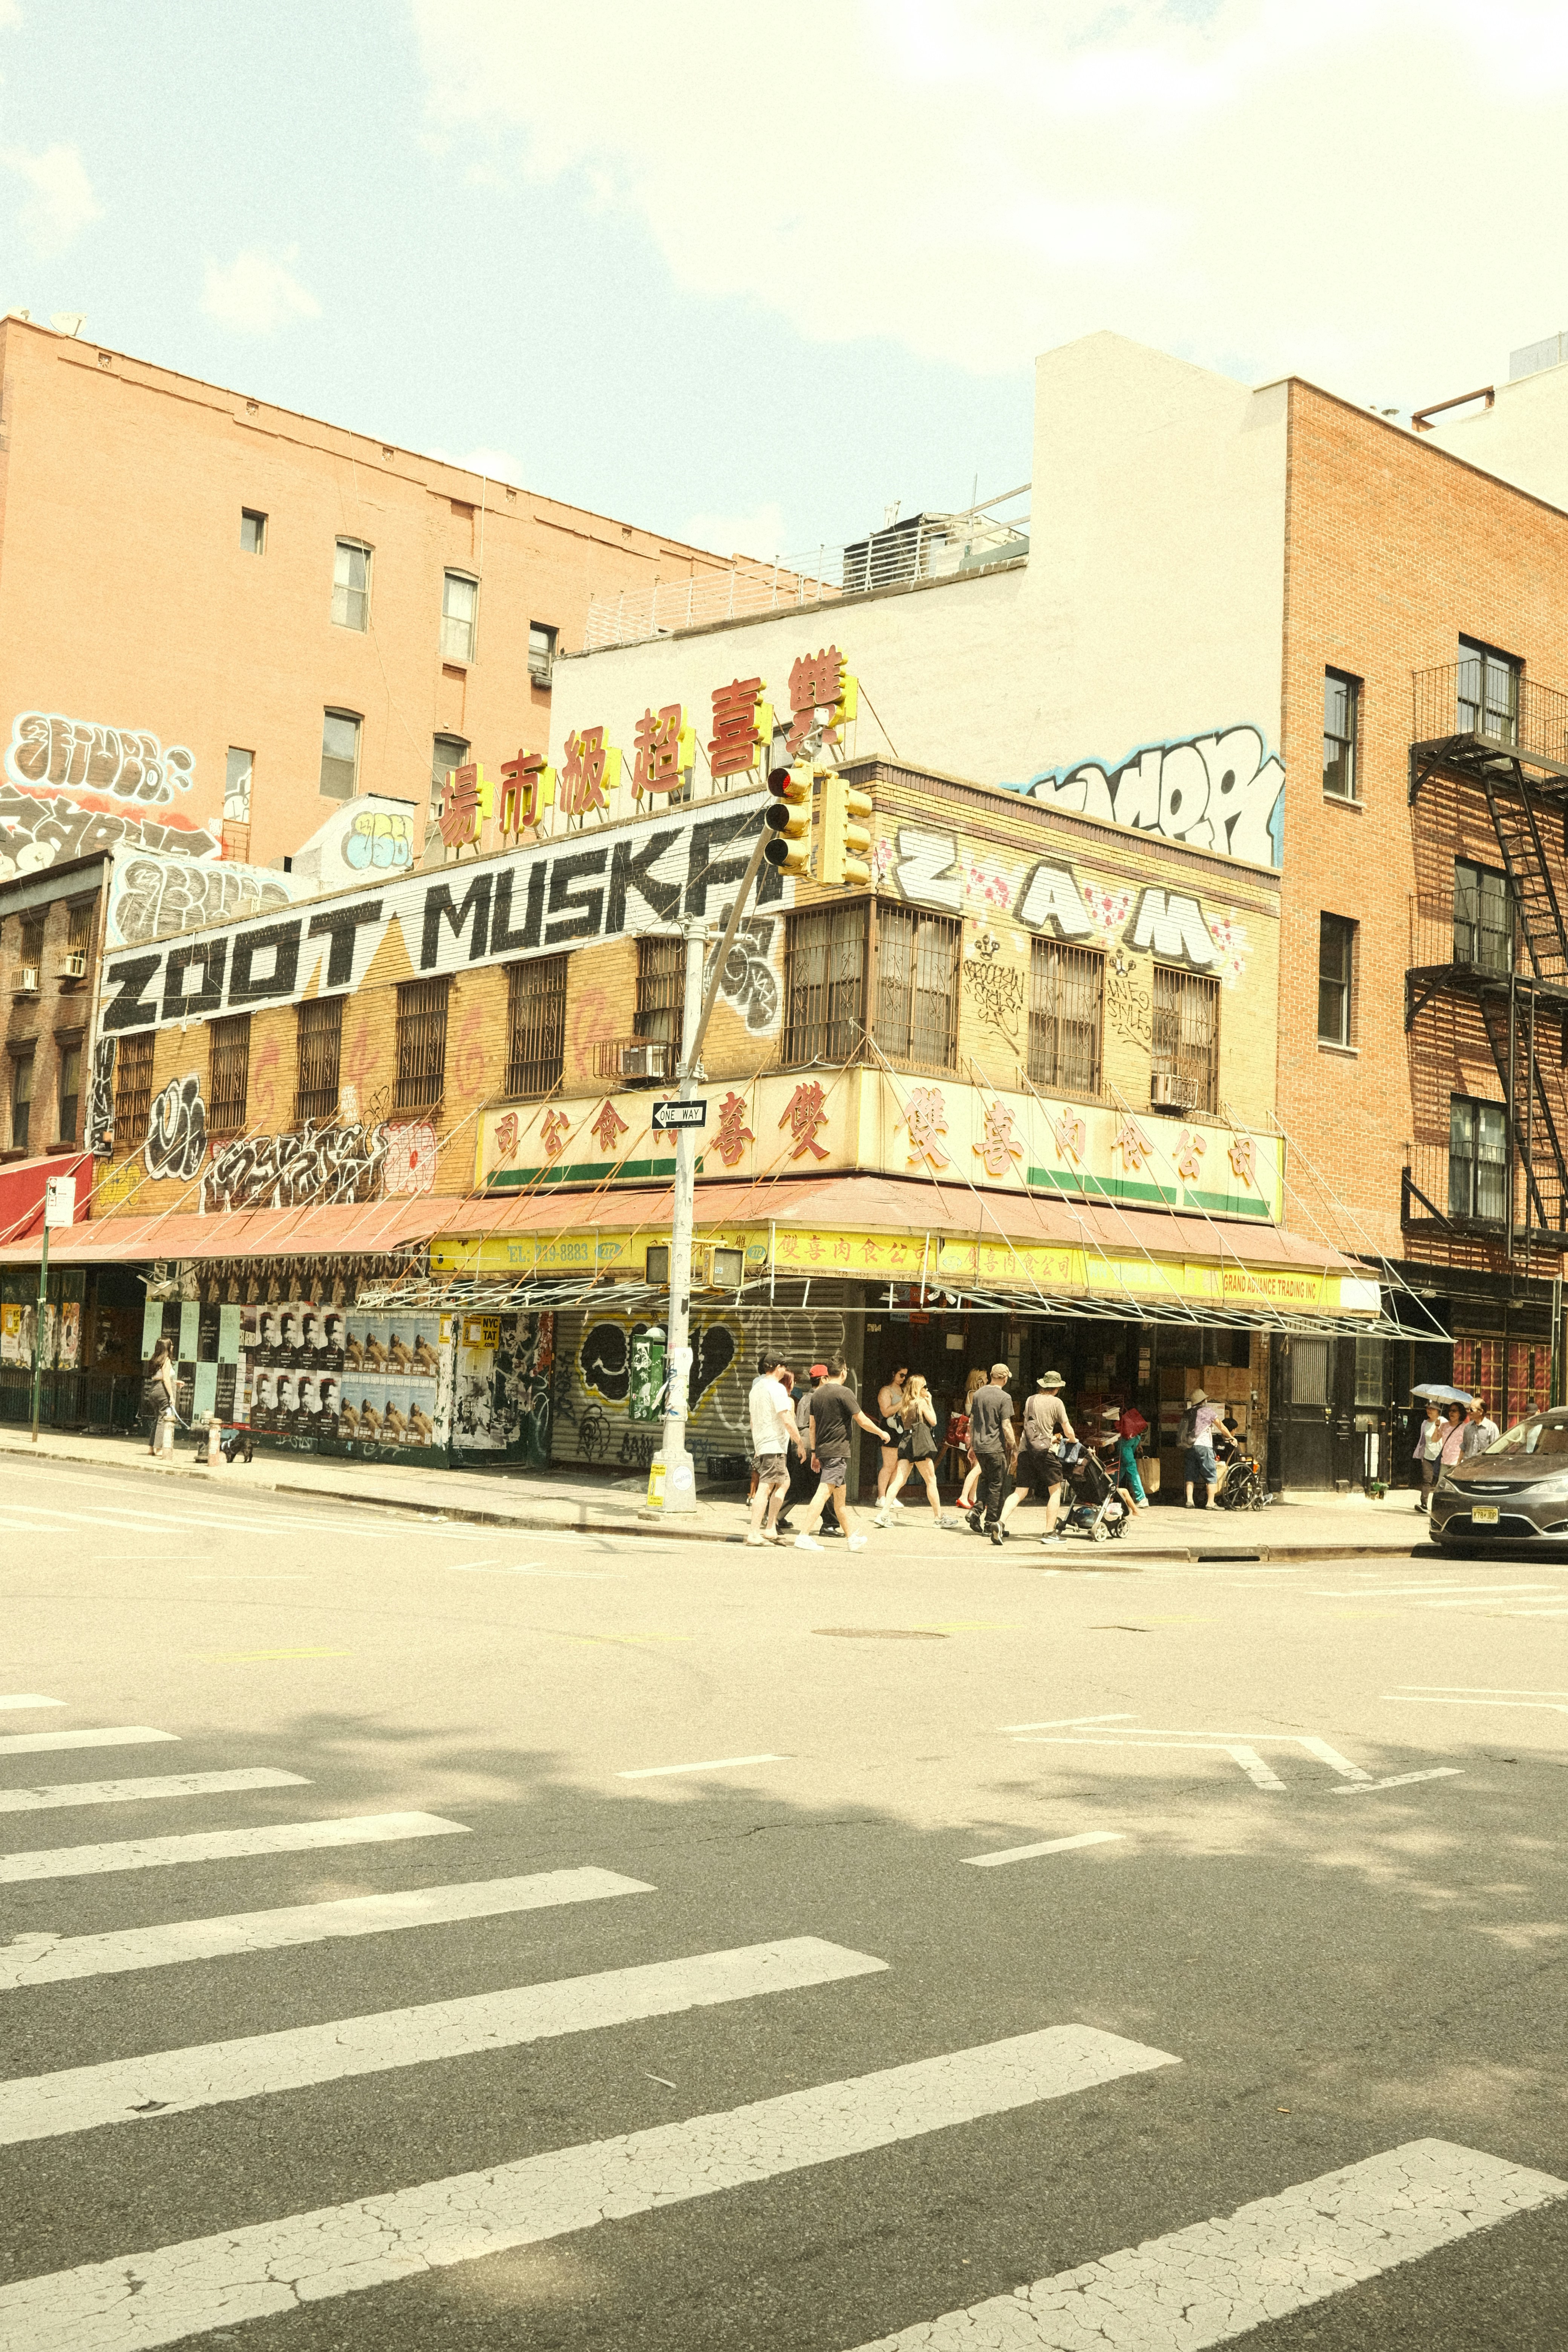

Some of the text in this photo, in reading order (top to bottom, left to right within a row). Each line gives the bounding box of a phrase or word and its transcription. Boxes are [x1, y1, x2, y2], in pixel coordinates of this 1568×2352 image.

[660, 1109, 699, 1121] ONE WAY
[536, 1243, 588, 1262] 219-8883
[602, 1244, 616, 1259] 272
[751, 1248, 762, 1257] 272
[776, 1234, 931, 1266] 雙喜肉食公司
[1224, 1274, 1246, 1292] GRAND
[1247, 1277, 1276, 1295] ADVANCE
[1278, 1279, 1304, 1298] TRADING
[1306, 1282, 1316, 1300] INC
[483, 1318, 498, 1328] NYC
[483, 1331, 497, 1340] TAT
